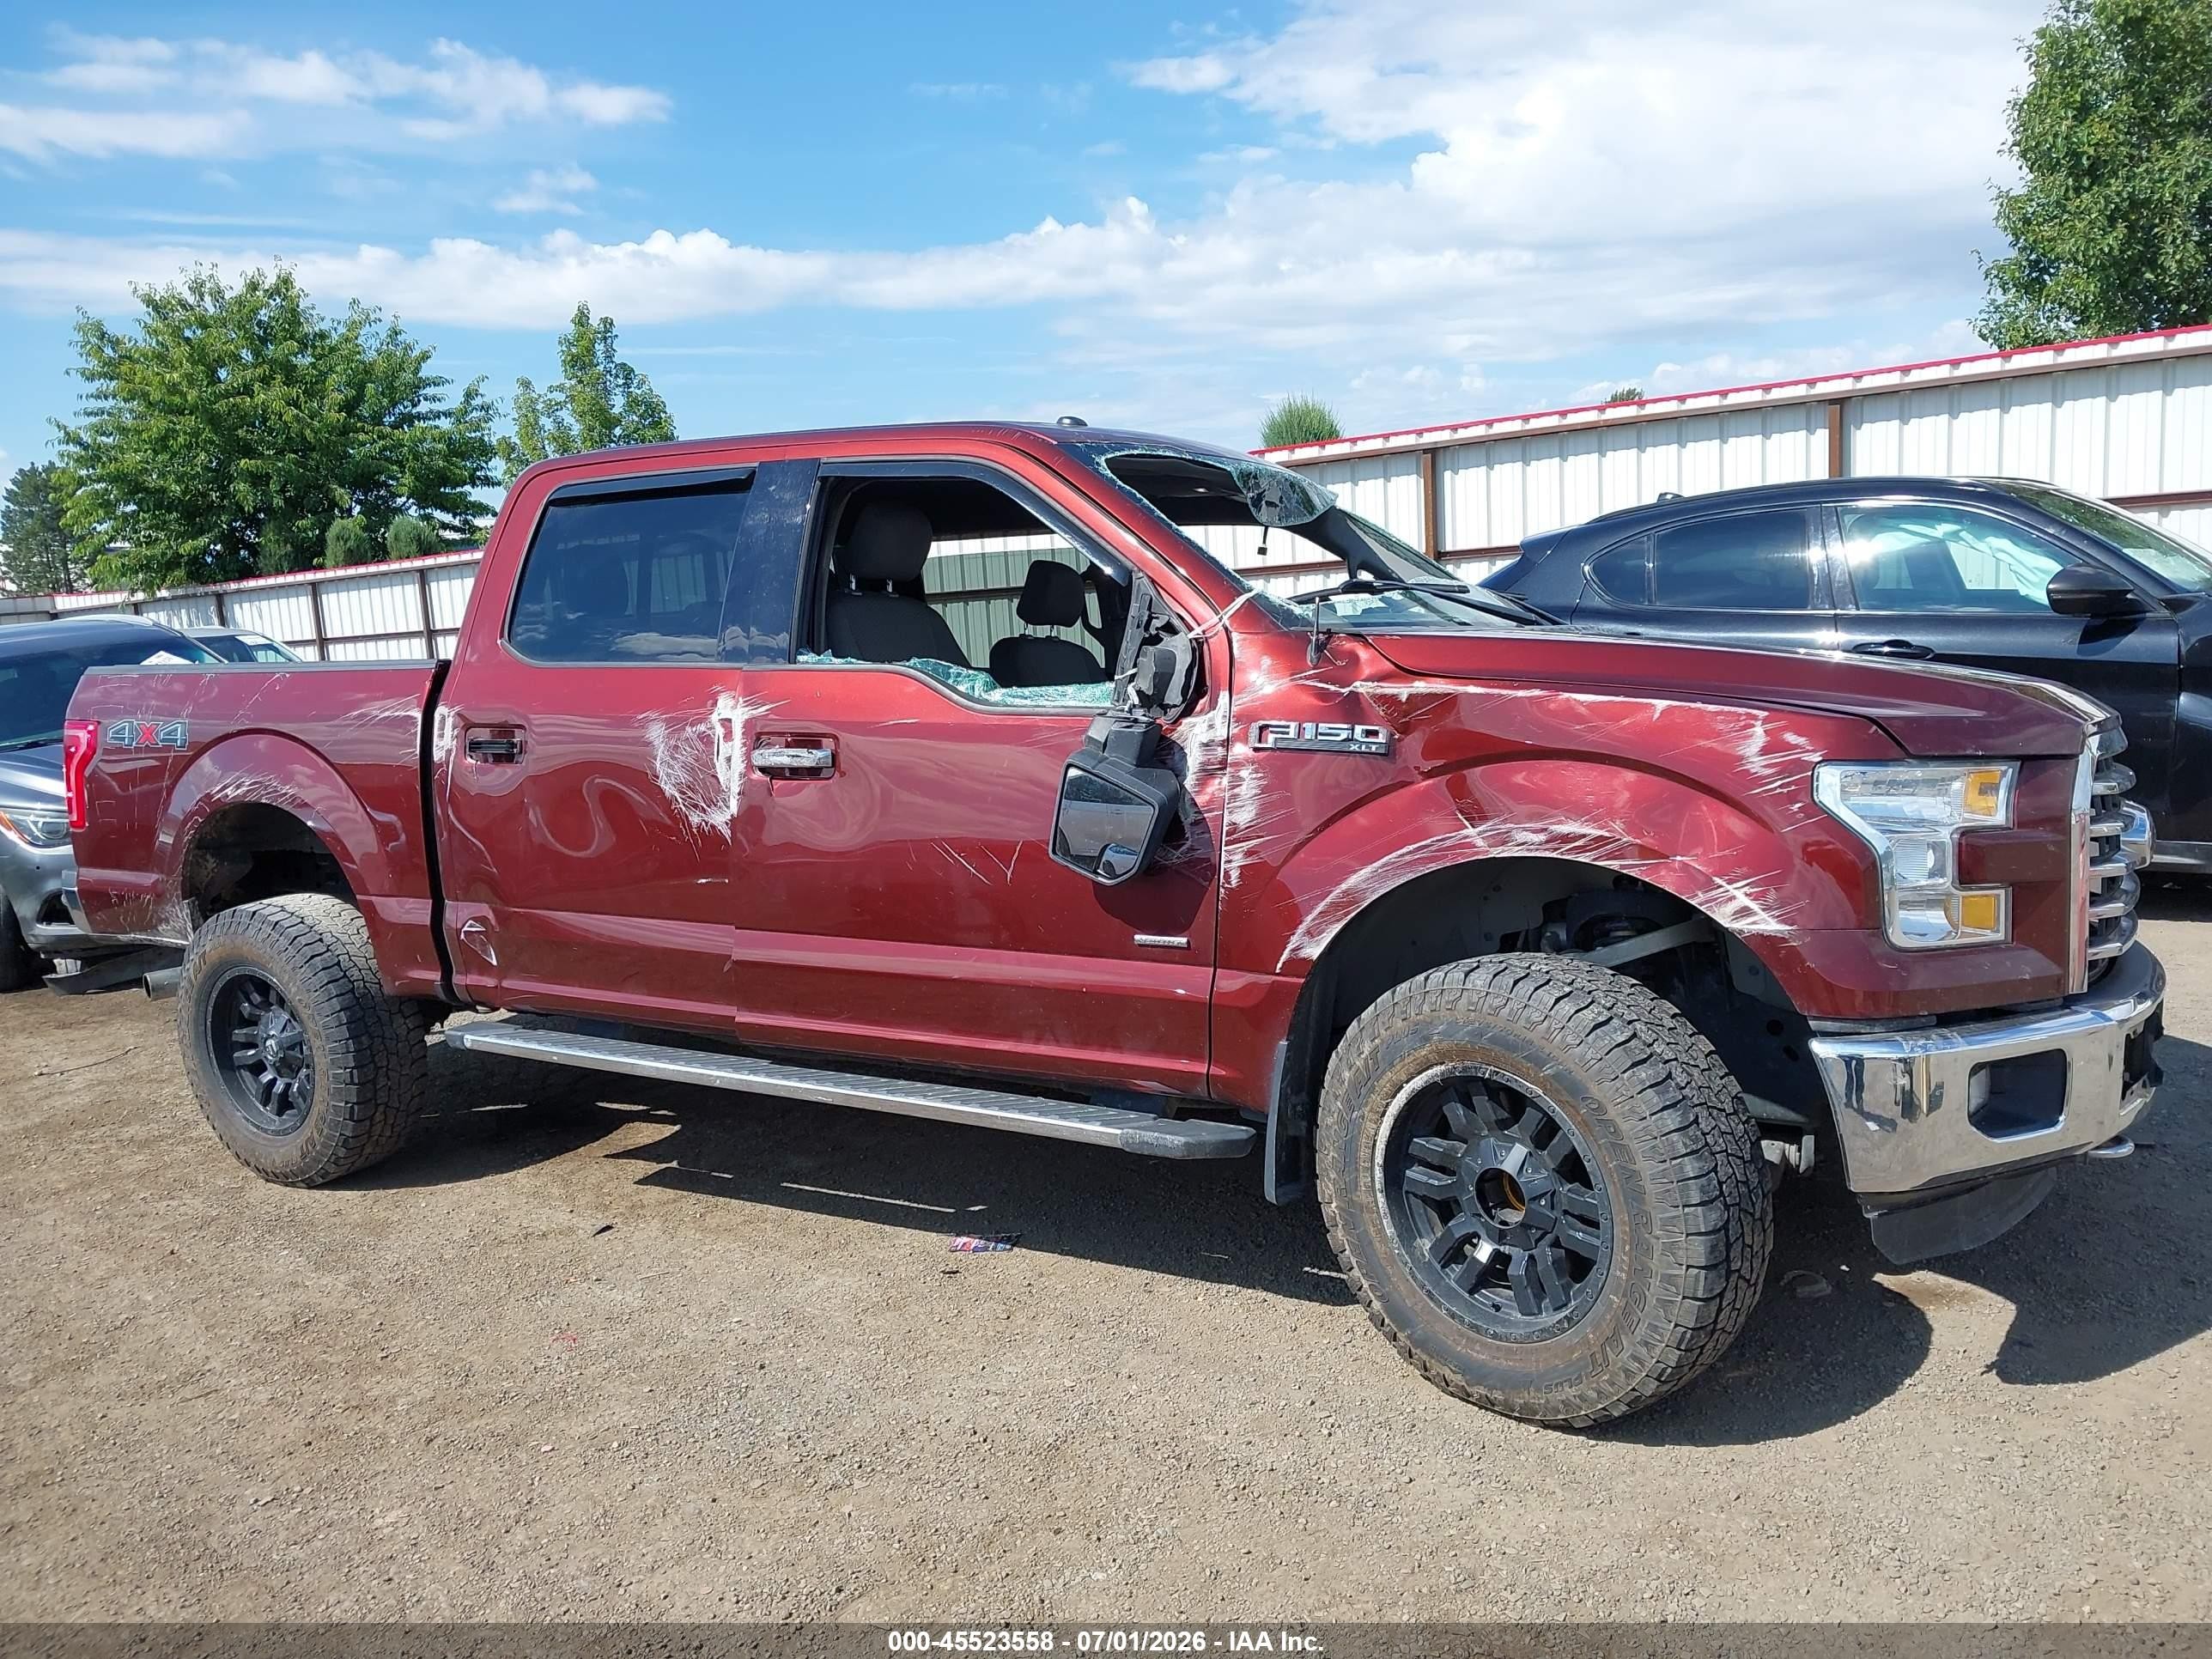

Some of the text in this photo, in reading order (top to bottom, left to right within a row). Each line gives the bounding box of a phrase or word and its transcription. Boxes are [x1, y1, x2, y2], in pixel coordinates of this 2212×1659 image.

[1580, 1096, 1646, 1195] OPEN
[1622, 1204, 1653, 1334] RANGE
[1544, 1372, 1583, 1395] PLUS
